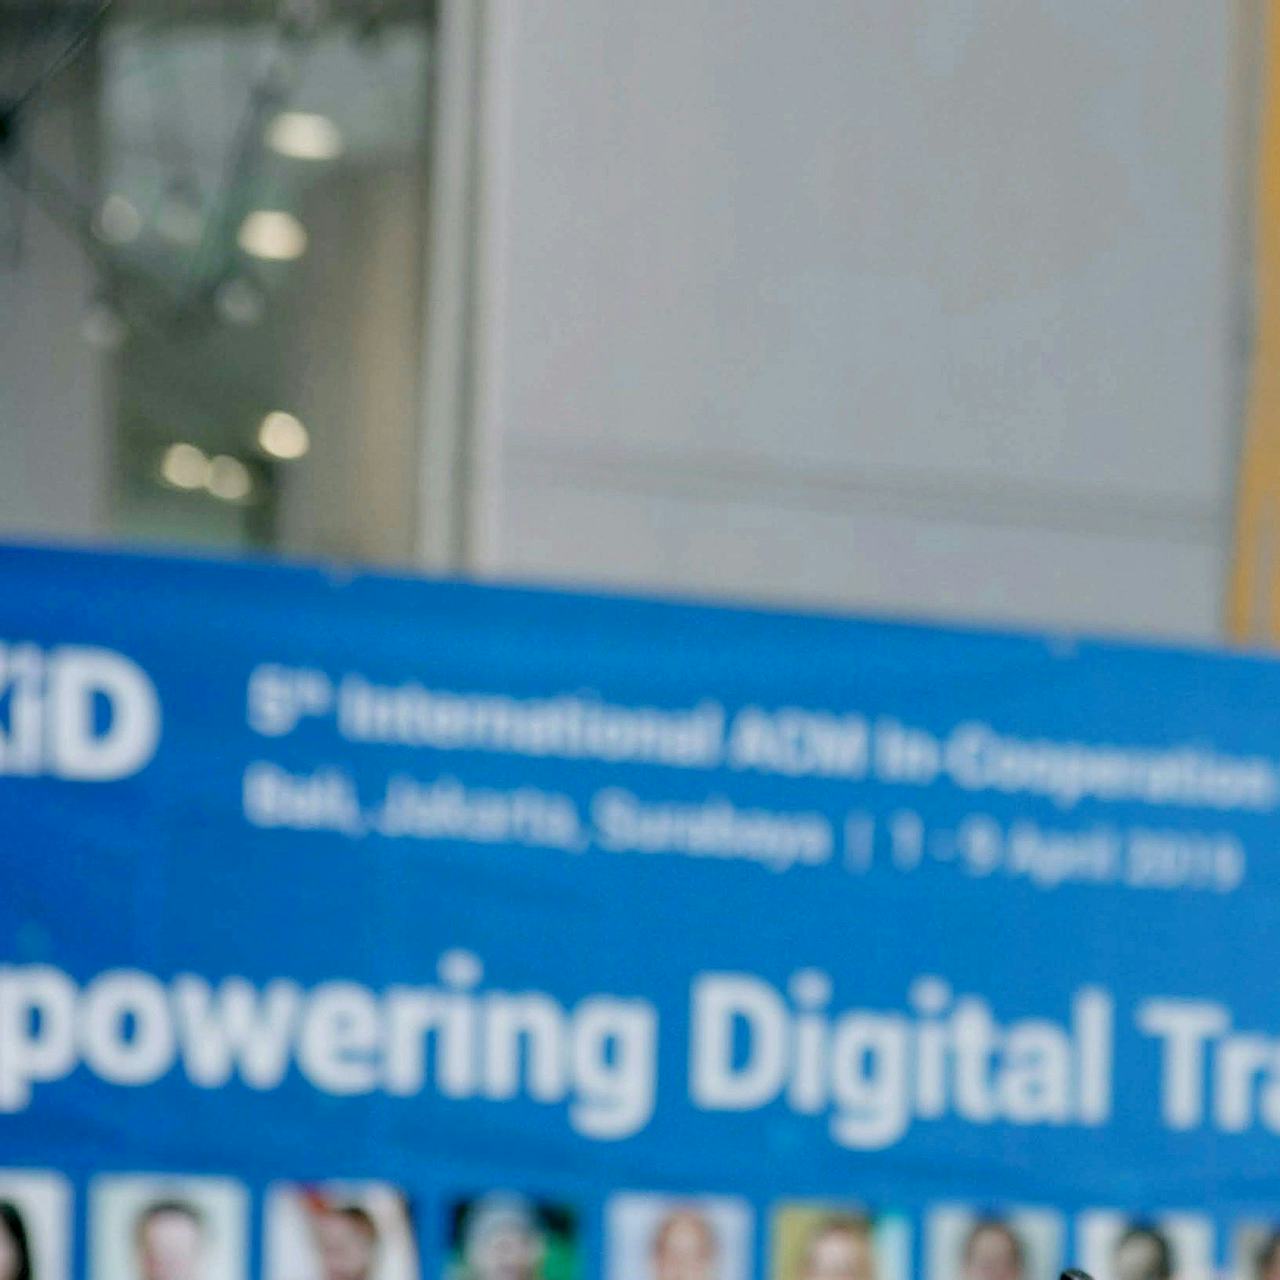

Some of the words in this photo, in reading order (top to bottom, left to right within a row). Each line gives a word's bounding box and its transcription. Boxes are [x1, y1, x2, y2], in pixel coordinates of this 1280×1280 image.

[338, 676, 723, 767] International
[729, 707, 868, 778] ACM
[593, 790, 831, 870] Surabaya
[1009, 822, 1118, 886] April
[0, 951, 658, 1139] powering
[690, 970, 1113, 1149] Digital
